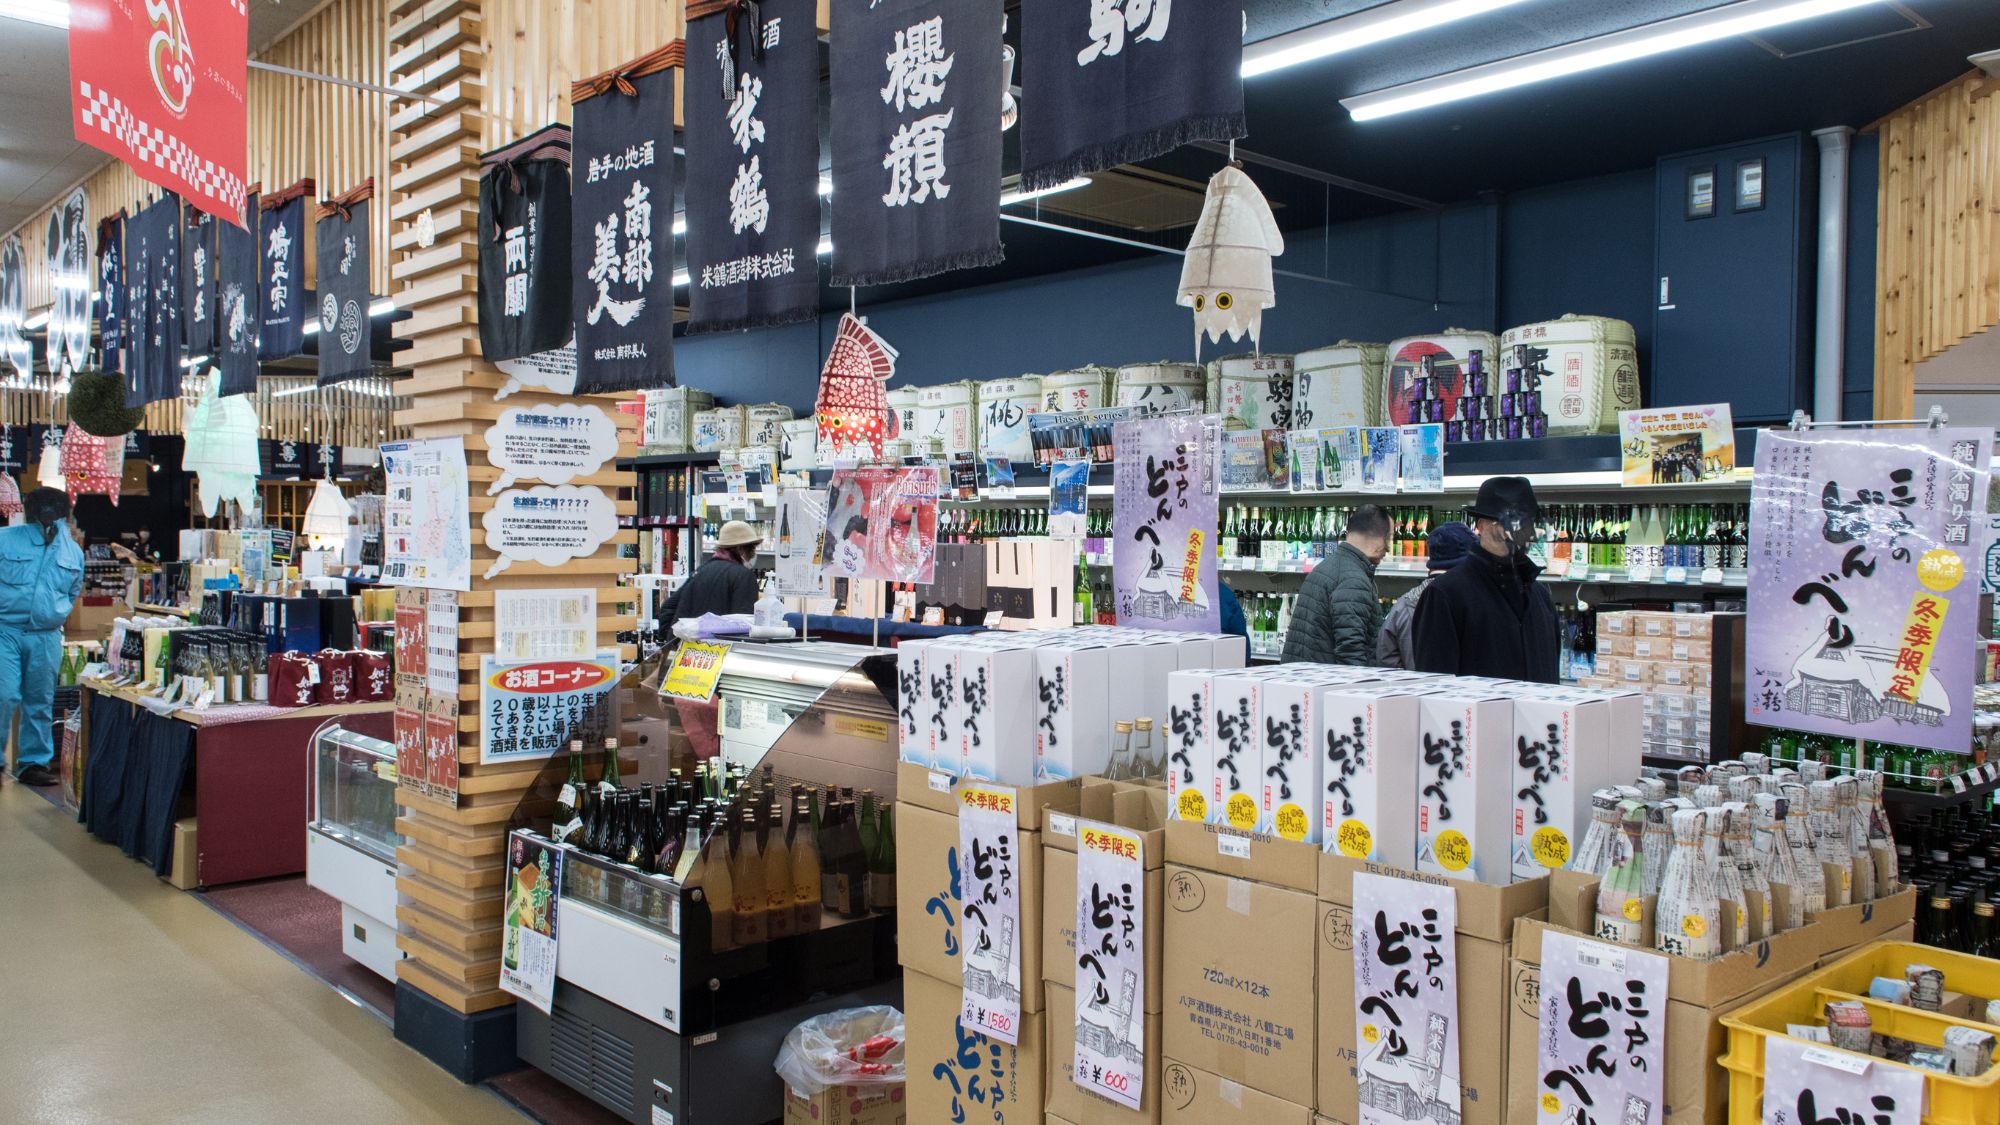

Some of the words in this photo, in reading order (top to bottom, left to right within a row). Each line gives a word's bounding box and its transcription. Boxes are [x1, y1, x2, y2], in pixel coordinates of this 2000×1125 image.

[586, 140, 655, 184] 岩手の地酒
[725, 71, 770, 236] 米鶴
[587, 213, 646, 327] 美人
[623, 179, 652, 293] 南部
[700, 247, 795, 290] 米鶴酒造株式会社
[1566, 358, 1581, 388] 清酒
[1093, 410, 1124, 421] series
[1134, 454, 1174, 571] どんべり
[1943, 441, 1977, 546] 純米濁り酒
[1180, 531, 1202, 604] 冬季限定
[1792, 479, 1886, 649] どんべり
[505, 667, 602, 689] お酒コーナー
[1887, 598, 1941, 704] 冬季限定
[900, 669, 917, 736] どんべり
[931, 673, 949, 742] どんべり
[963, 676, 982, 747] どんべり
[1039, 675, 1058, 746] どんべり
[1170, 704, 1195, 784] どんべり
[1217, 709, 1242, 791] どんべり
[1266, 715, 1294, 800] どんべり
[1327, 728, 1356, 817] どんべり
[1423, 732, 1452, 821] どんべり
[964, 790, 1013, 815] 冬季限定
[1179, 794, 1205, 819] 熟成
[1228, 798, 1256, 825] 熟成
[1517, 735, 1549, 825] どんべり
[1084, 831, 1138, 862] 冬季限定
[1203, 823, 1218, 834] TEL
[1218, 825, 1272, 844] 0178-43-0010
[1277, 810, 1307, 835] 熟成
[1339, 826, 1368, 856] 熟成
[1438, 839, 1469, 865] 熟成
[1532, 836, 1566, 863] 熟成
[963, 837, 999, 951] どんべり
[998, 834, 1013, 900] 三戸の
[1364, 862, 1382, 875] TEL
[1079, 882, 1119, 1006] どんべり
[1119, 883, 1136, 952] 三戸の
[1421, 908, 1444, 992] 三戸の
[1178, 995, 1252, 1027] 八戸酒類株式会社
[1360, 910, 1420, 1057] どんべり
[1200, 1027, 1215, 1040] TEL
[1216, 1031, 1270, 1056] 0178-43-0010
[1624, 979, 1650, 1073] 三戸の
